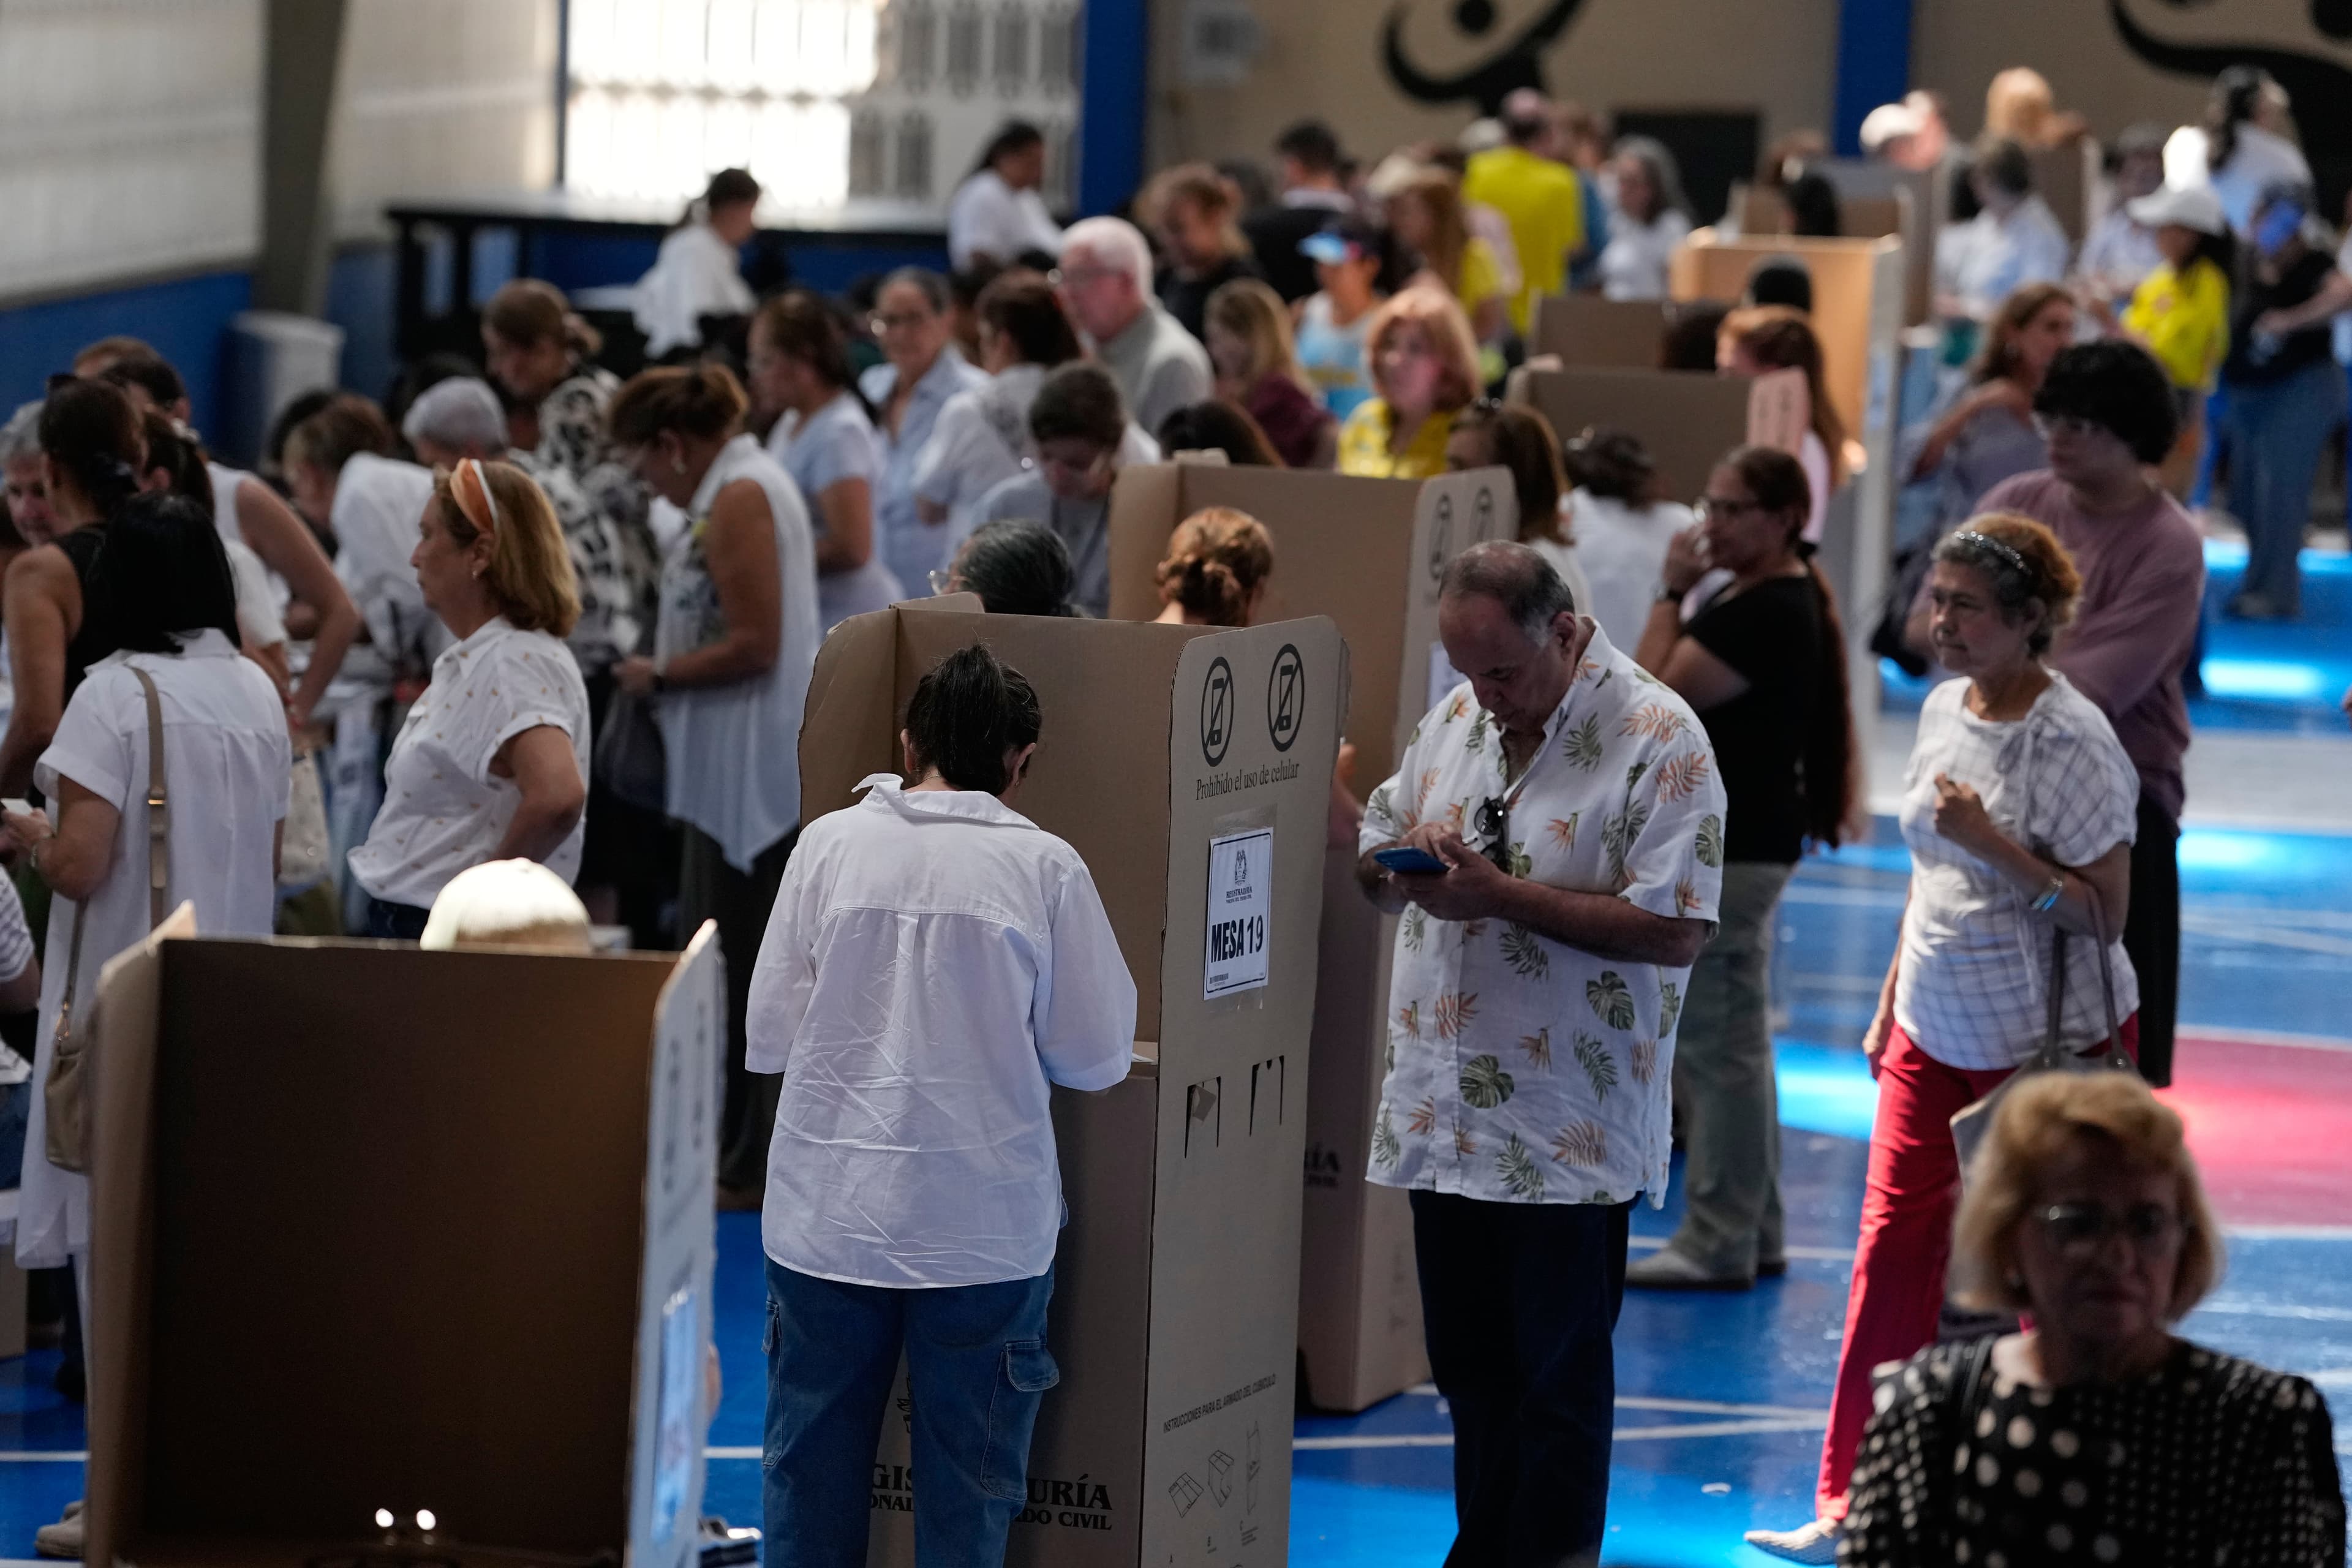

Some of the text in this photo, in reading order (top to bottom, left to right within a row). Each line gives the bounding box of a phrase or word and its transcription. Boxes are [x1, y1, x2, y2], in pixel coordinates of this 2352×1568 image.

[1196, 759, 1299, 800] Prohibido el uso de celular
[1211, 915, 1263, 963] MESA 19
[1164, 1407, 1201, 1433] INSTRUCCIONES
[1202, 1401, 1215, 1417] PARA
[1058, 1512, 1112, 1530] CIVIL
